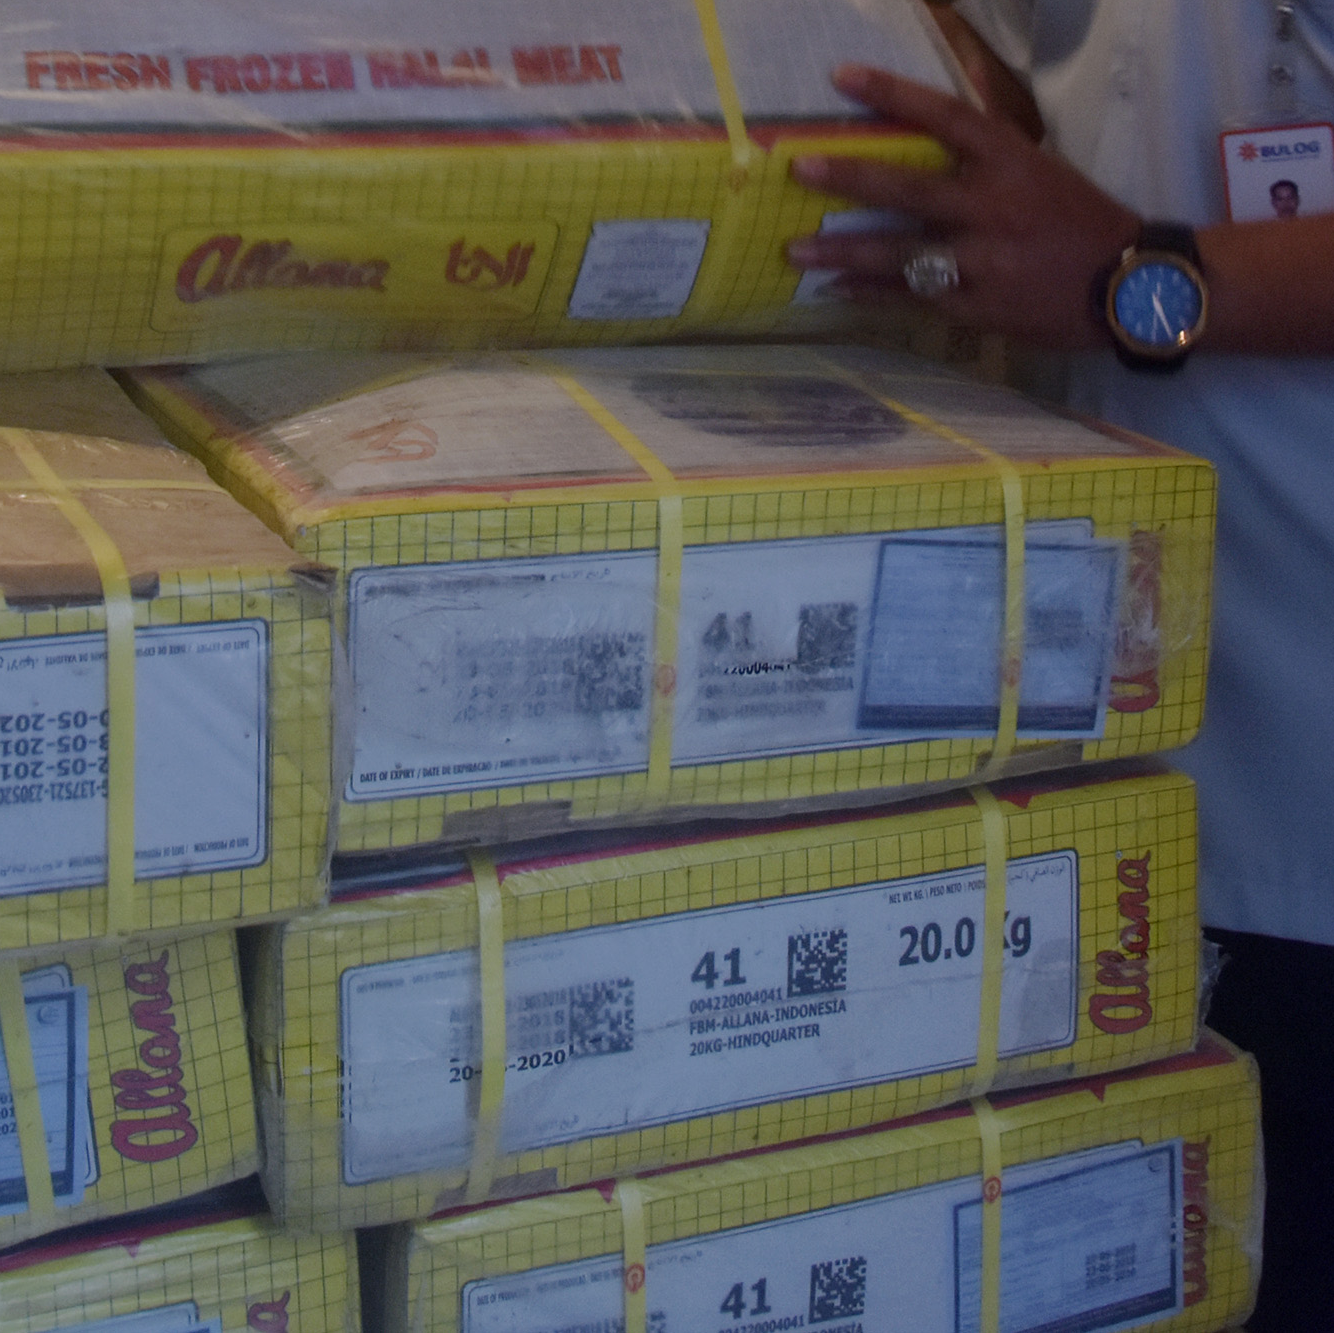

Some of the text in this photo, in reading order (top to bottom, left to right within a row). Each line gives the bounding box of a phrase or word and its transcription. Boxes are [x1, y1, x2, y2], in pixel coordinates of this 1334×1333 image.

[183, 50, 356, 95] FROZEN
[510, 43, 624, 87] MEAT
[1260, 139, 1322, 161] BULOG
[175, 234, 393, 304] Allana
[360, 770, 378, 783] DATE
[380, 770, 388, 782] OF
[390, 767, 415, 781] EXPIRY
[422, 766, 440, 778] DATE
[930, 885, 945, 898] PESO
[898, 916, 976, 967] 20.0
[1088, 849, 1153, 1034] Allana
[690, 947, 747, 990] 41
[689, 987, 783, 1015] 004220004041
[689, 998, 847, 1035] FBM-ALLANA-INDONESIA
[110, 948, 199, 1163] Allana
[689, 1023, 821, 1057] 20KG-HINDQUARTER
[449, 1049, 566, 1083] 20--2020
[719, 1277, 772, 1320] 41
